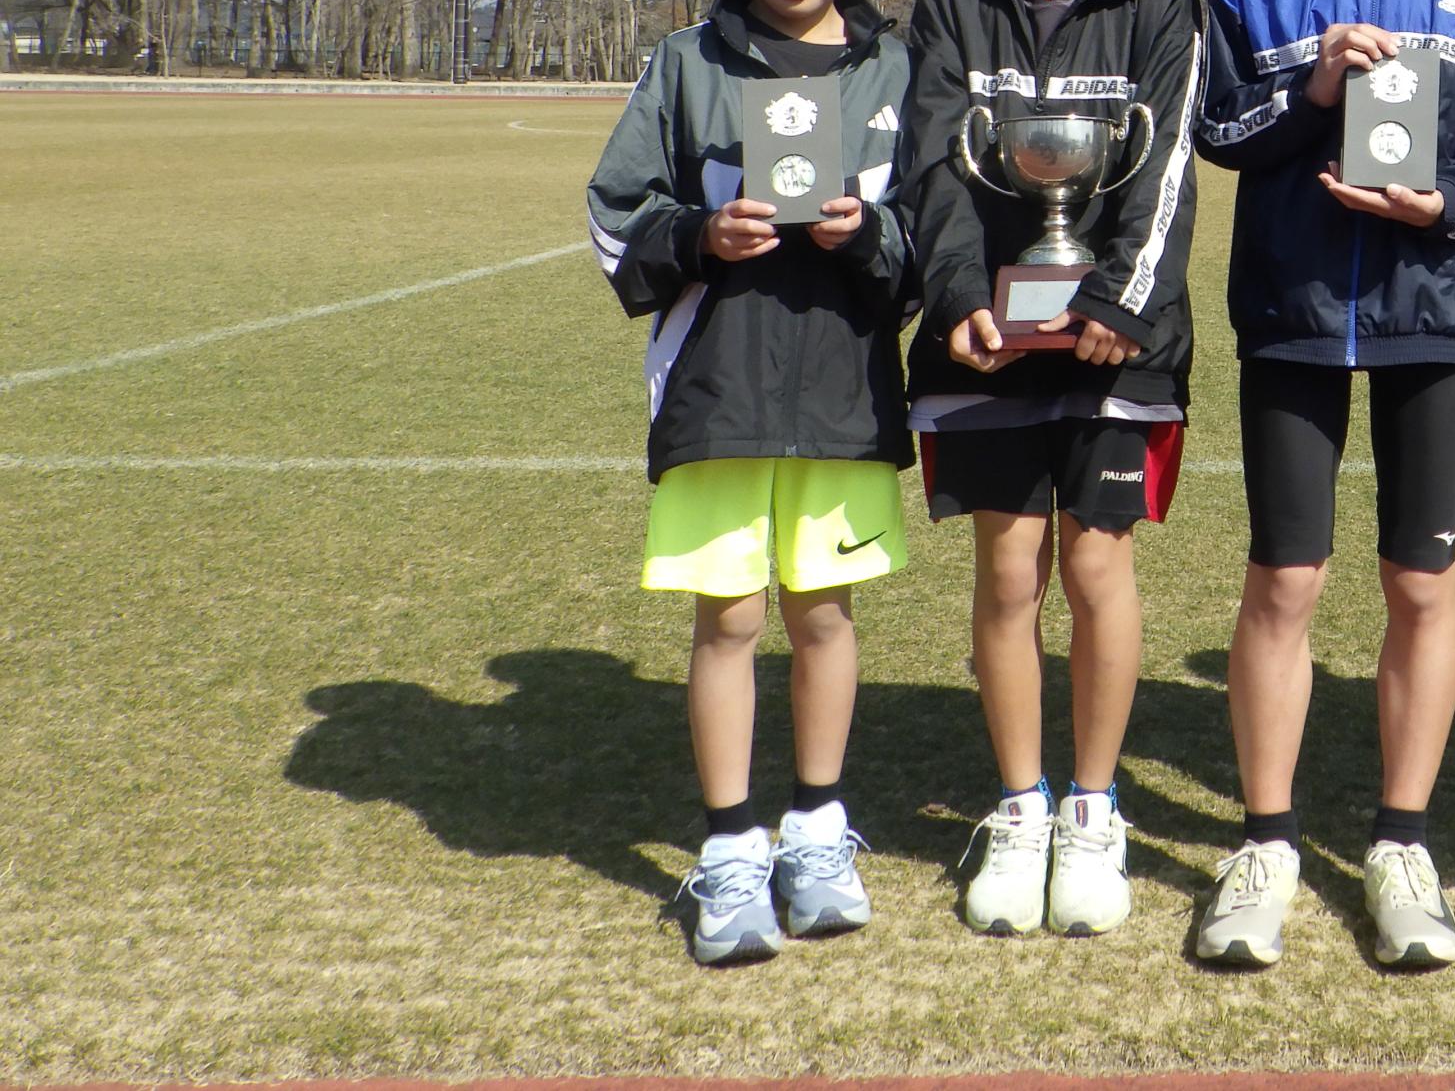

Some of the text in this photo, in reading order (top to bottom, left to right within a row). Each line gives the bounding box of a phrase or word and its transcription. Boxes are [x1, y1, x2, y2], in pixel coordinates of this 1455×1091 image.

[1060, 79, 1129, 96] ADIDAS
[1157, 175, 1176, 238] ADIDAS
[1099, 470, 1144, 483] PALDING
